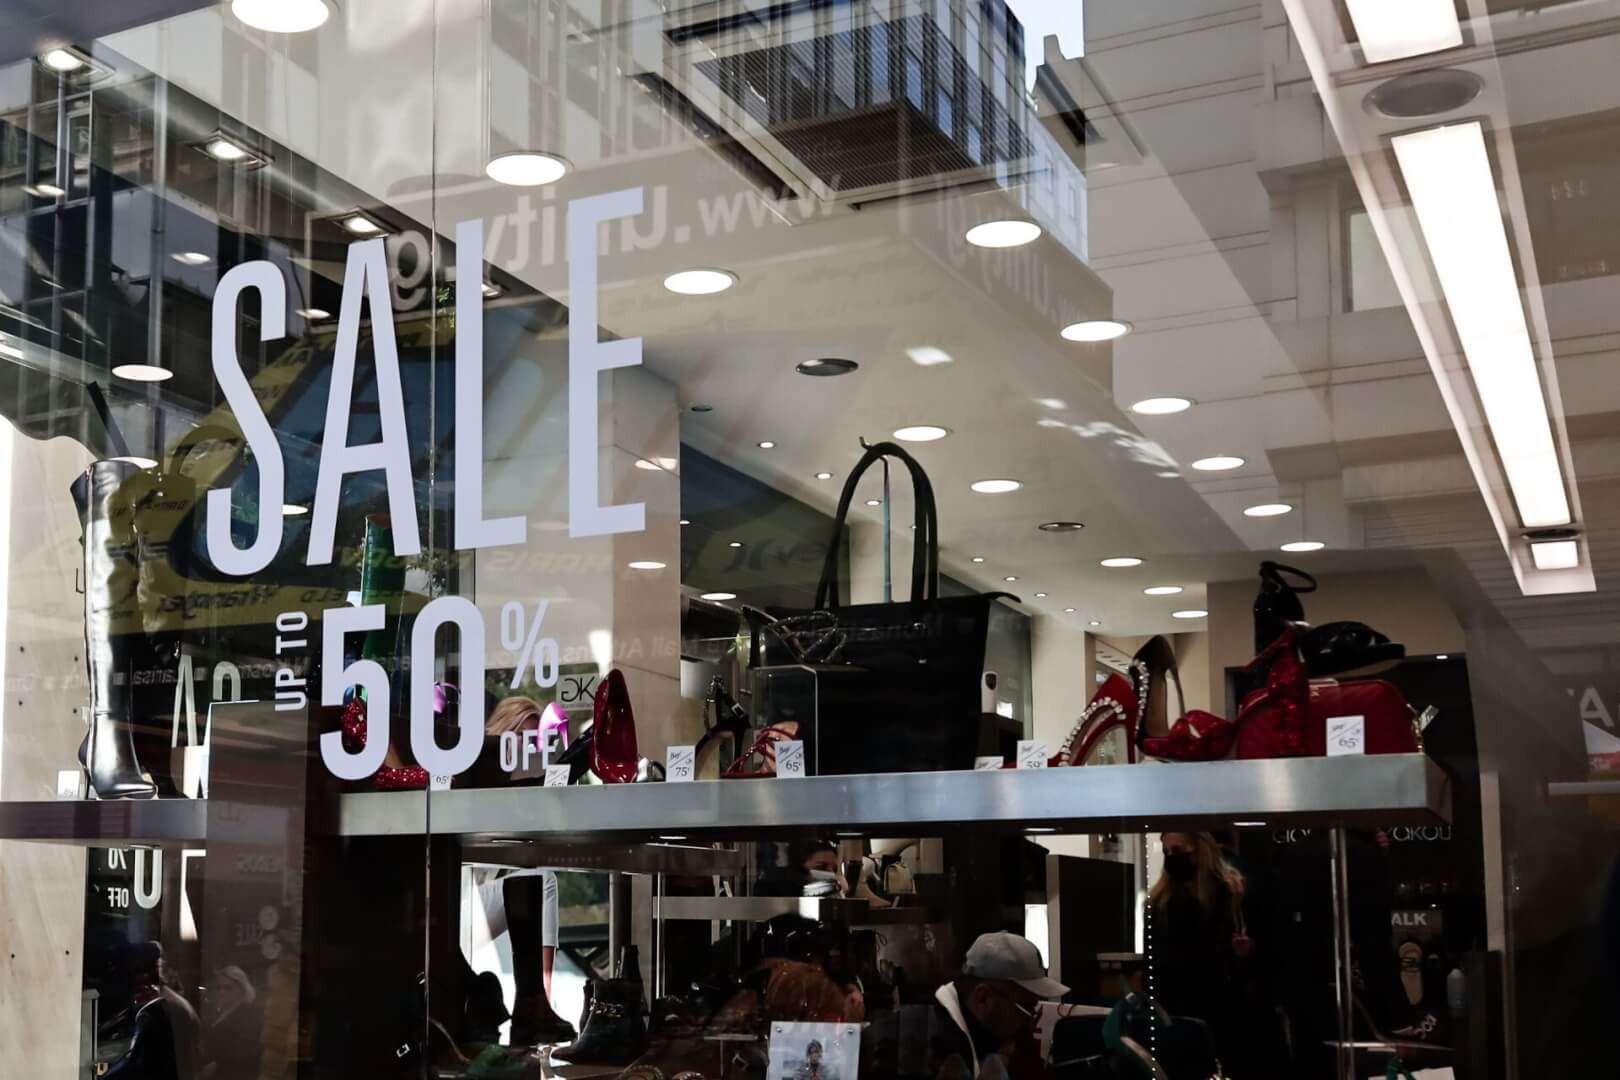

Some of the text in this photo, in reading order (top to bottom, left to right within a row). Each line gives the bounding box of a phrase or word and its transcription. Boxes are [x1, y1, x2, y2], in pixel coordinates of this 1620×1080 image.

[207, 186, 646, 576] SALE
[275, 610, 308, 655] TO
[274, 667, 307, 712] UP
[500, 729, 559, 773] OFF
